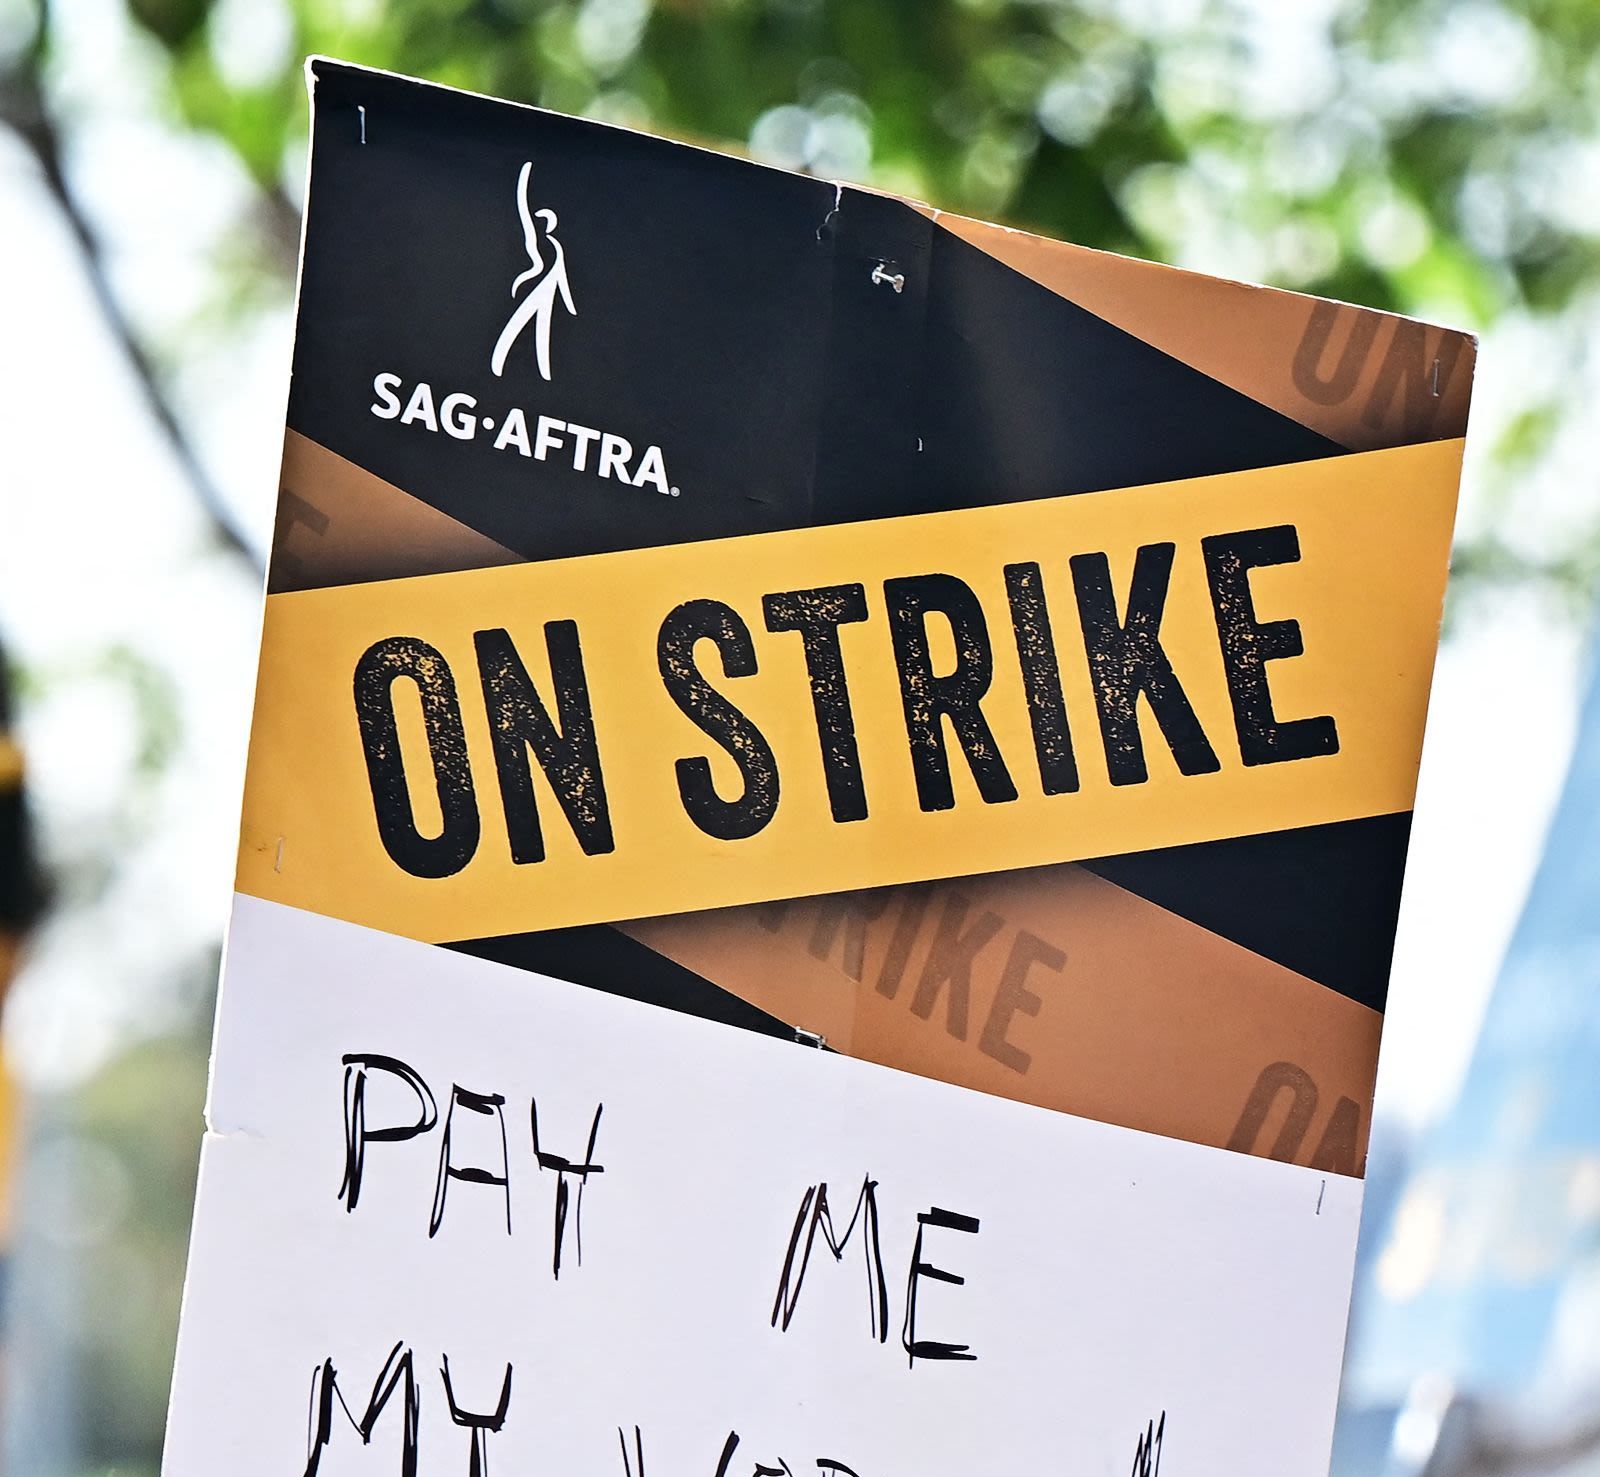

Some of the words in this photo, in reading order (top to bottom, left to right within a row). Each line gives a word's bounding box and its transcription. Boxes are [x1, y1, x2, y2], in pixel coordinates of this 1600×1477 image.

[353, 619, 614, 879] ON
[657, 525, 1339, 841] STRIKE
[339, 1052, 604, 1280] PAY
[771, 1173, 980, 1368] ME
